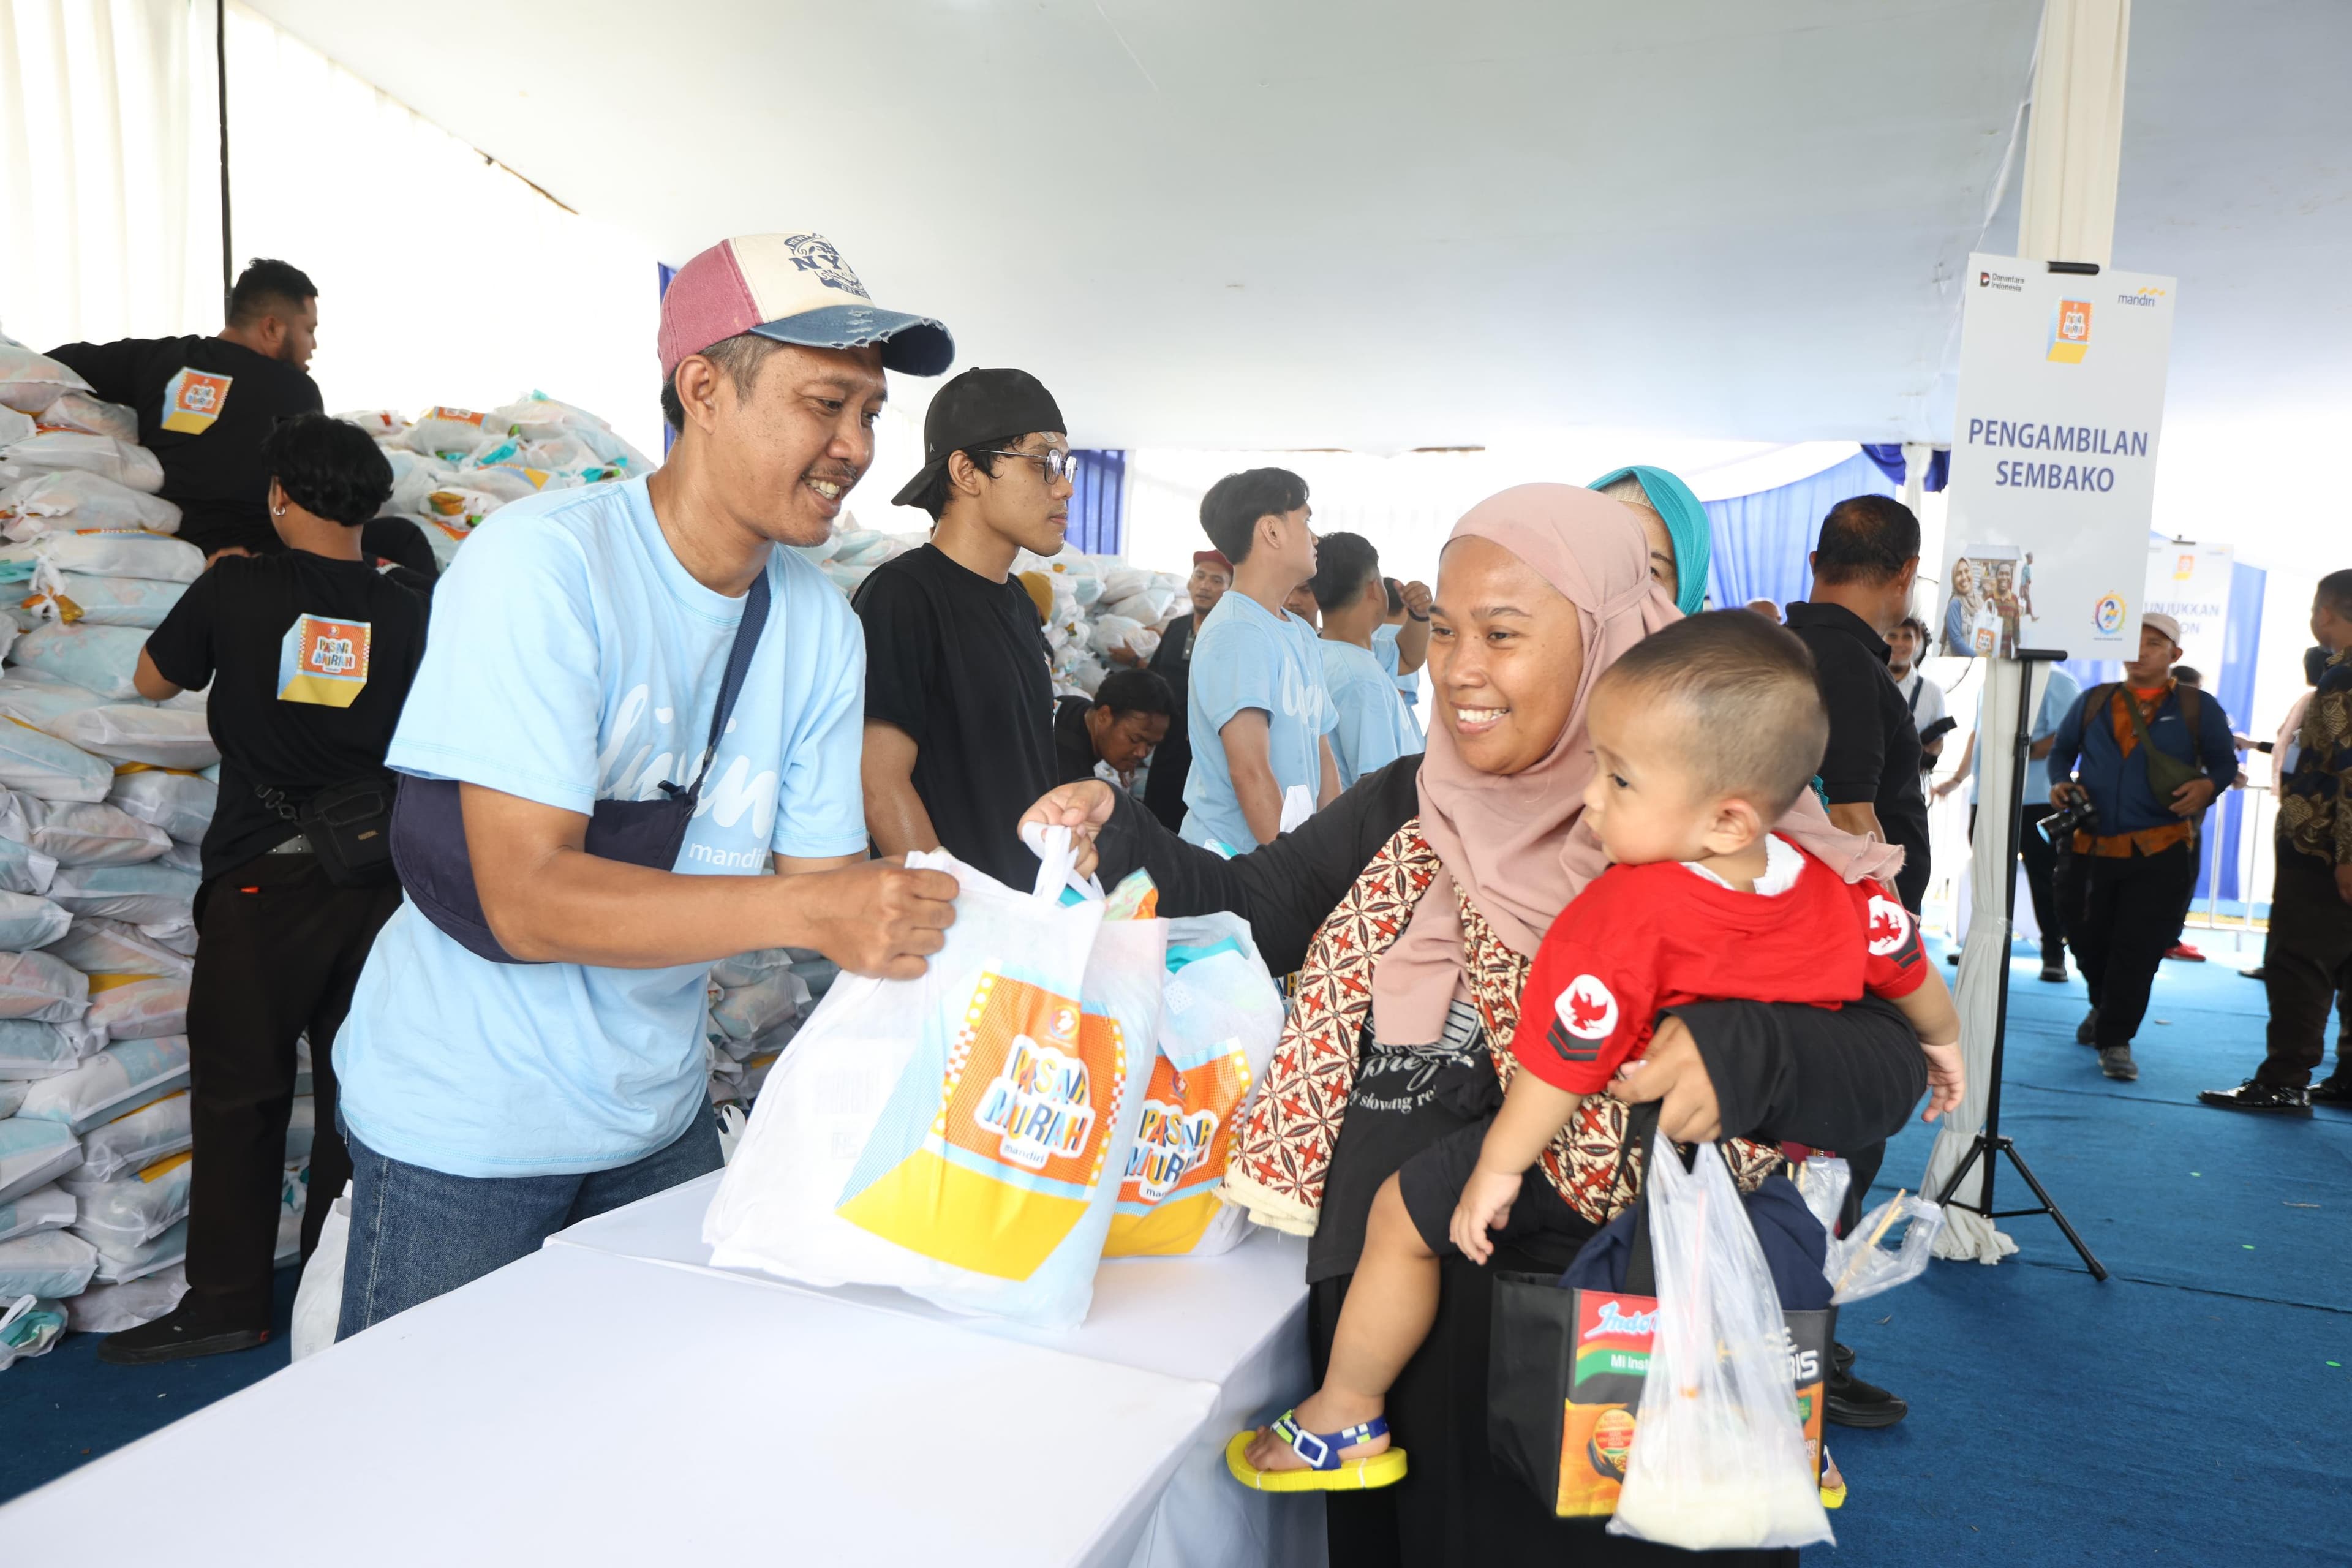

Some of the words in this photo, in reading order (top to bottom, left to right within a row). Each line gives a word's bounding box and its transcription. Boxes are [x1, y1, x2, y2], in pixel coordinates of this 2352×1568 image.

[1992, 273, 2025, 285] Danantara
[1992, 281, 2022, 292] Indonesia
[2117, 294, 2155, 307] mandiri
[1967, 418, 2149, 458] PENGAMBILAN
[1994, 460, 2115, 492] SEMBAKO
[2144, 601, 2220, 616] UNJUKKAN
[320, 639, 350, 654] PASAR
[314, 652, 353, 668] MURAH
[984, 1086, 1090, 1152] MURAH
[1138, 1107, 1214, 1154] PASAR
[1003, 1143, 1046, 1164] mandiri
[1610, 1354, 1626, 1368] Mi
